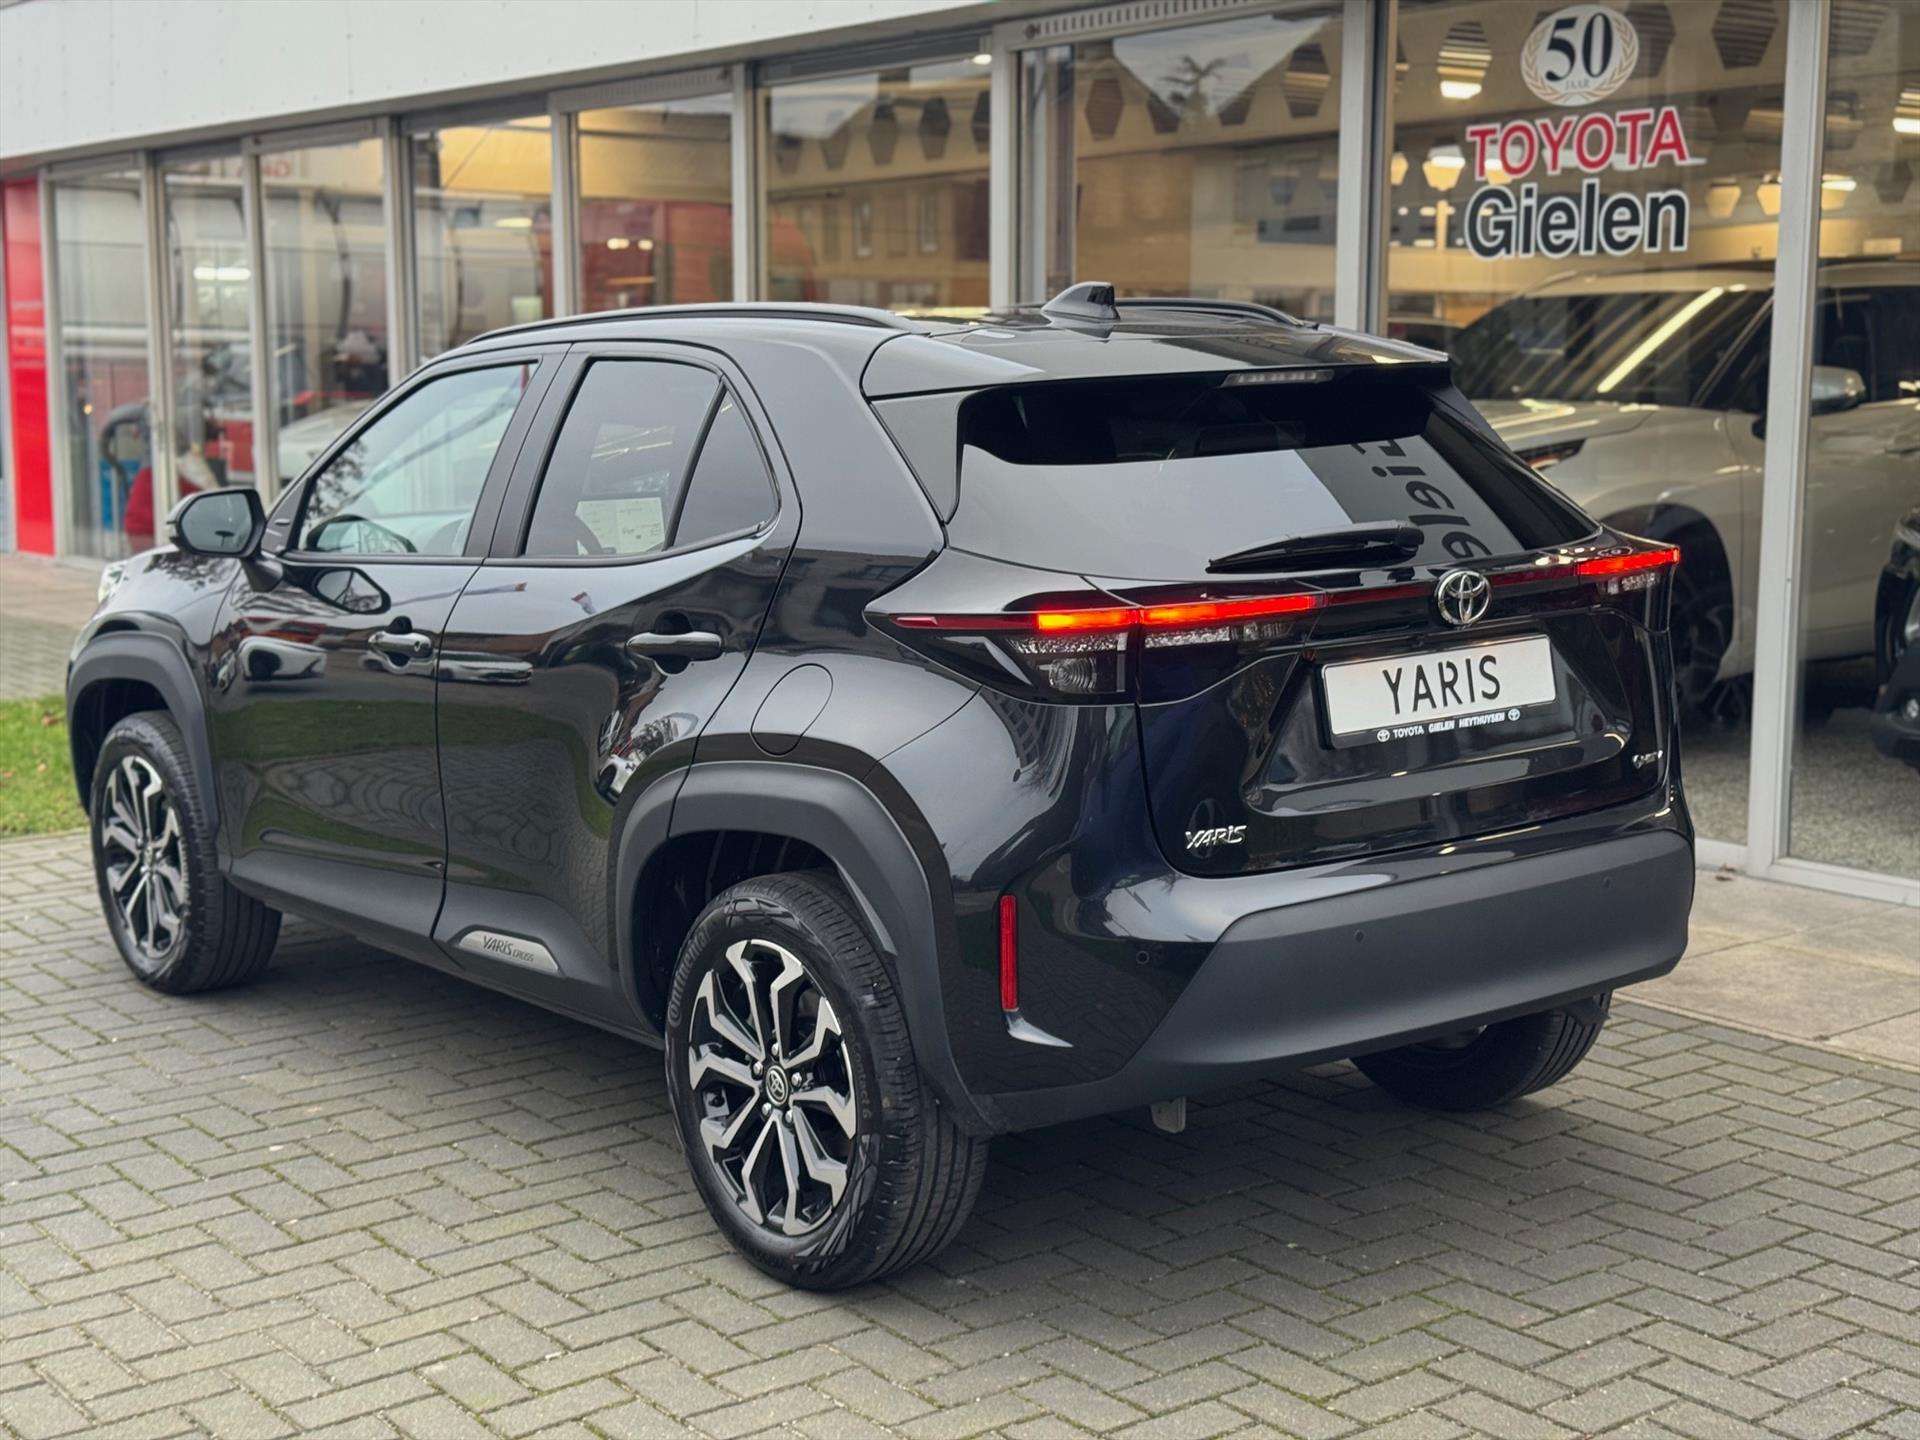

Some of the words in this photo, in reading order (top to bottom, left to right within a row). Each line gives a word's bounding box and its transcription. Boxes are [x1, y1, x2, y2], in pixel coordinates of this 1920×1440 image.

[1544, 12, 1613, 82] 50
[1467, 107, 1689, 180] TOYOTA
[1465, 178, 1689, 259] Gielen
[1382, 655, 1501, 715] YARIS
[1393, 725, 1424, 738] TOYOTA
[1428, 719, 1455, 733] GIELEN
[1185, 825, 1247, 850] YARIS
[483, 936, 513, 955] YARIS
